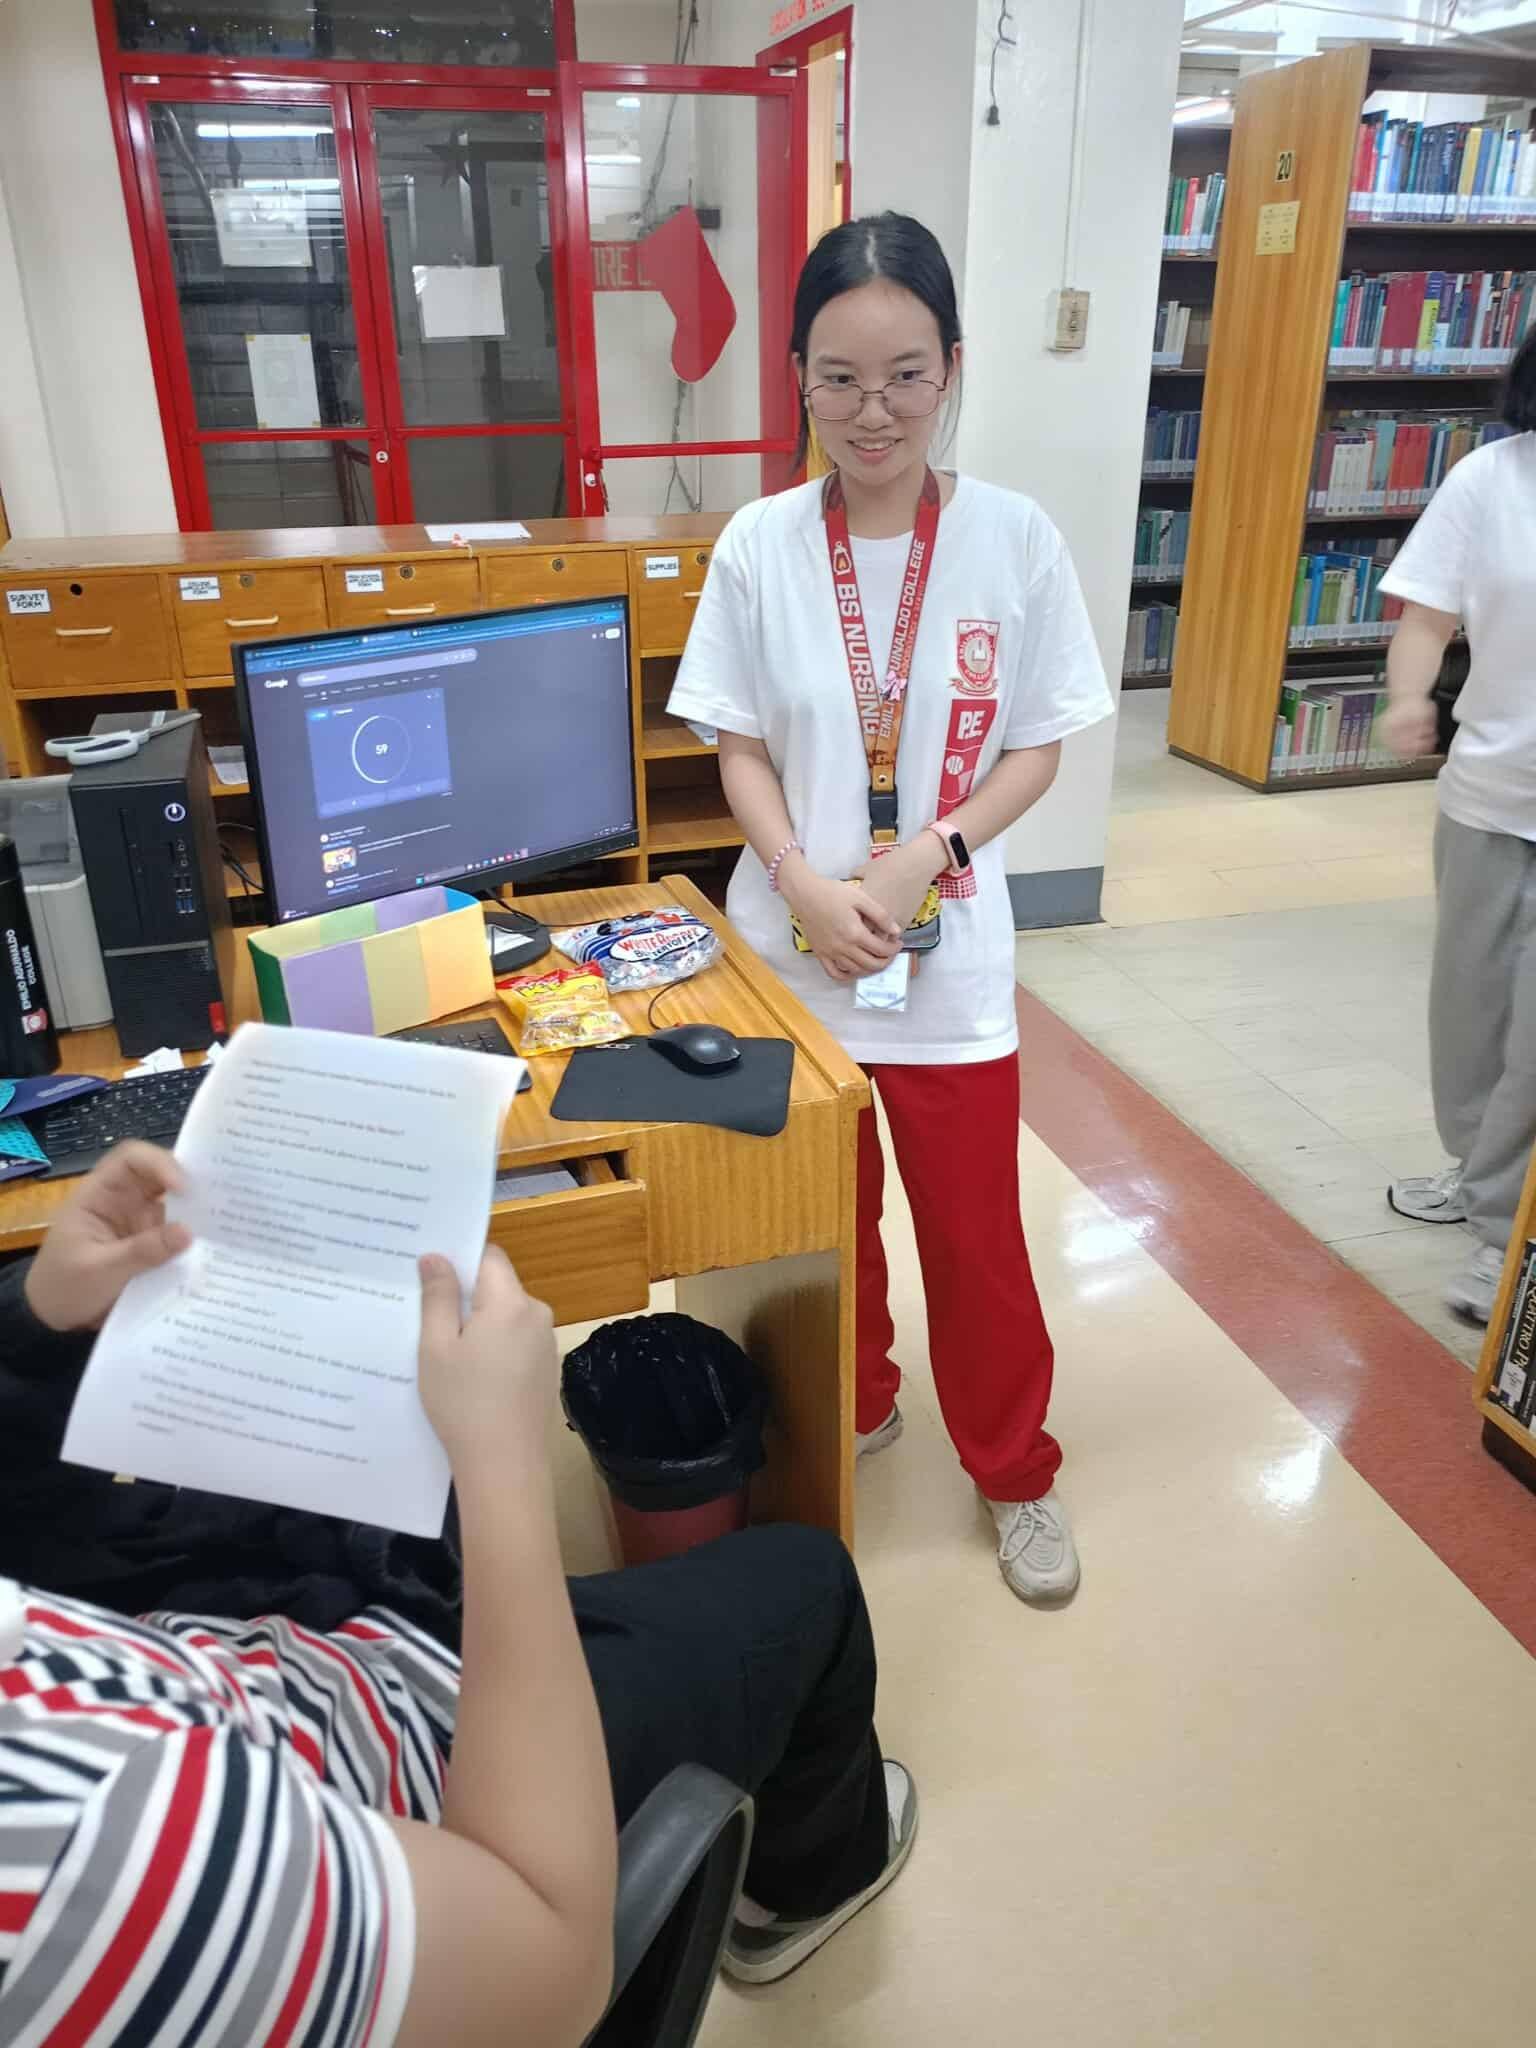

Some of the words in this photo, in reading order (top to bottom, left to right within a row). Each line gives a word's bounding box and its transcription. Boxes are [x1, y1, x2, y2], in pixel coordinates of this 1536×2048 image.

[1277, 152, 1292, 181] 20
[902, 539, 926, 606] COLLEGE
[10, 593, 45, 602] SURVEY
[16, 600, 42, 609] FORM
[836, 583, 861, 617] BS
[843, 622, 882, 736] NURSING
[375, 743, 389, 755] 59
[6, 928, 25, 981] AGUINALDO
[22, 945, 37, 985] COLLEGE
